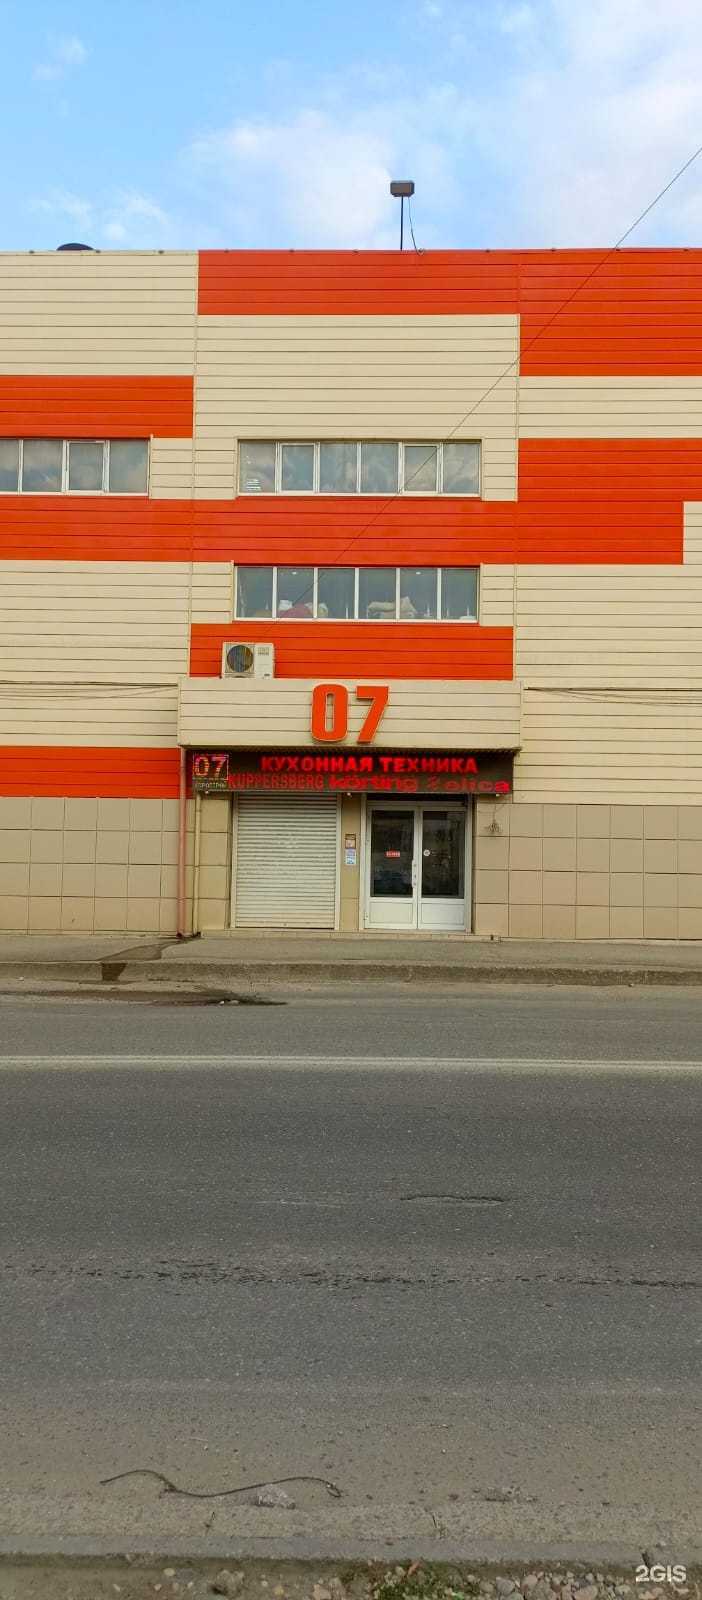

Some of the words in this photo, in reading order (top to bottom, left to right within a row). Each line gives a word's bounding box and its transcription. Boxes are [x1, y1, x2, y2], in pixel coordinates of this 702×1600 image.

[311, 683, 390, 743] 07
[194, 756, 228, 777] 07
[261, 756, 373, 772] КУХОННАЯ
[379, 757, 477, 774] ТЕХНИКА
